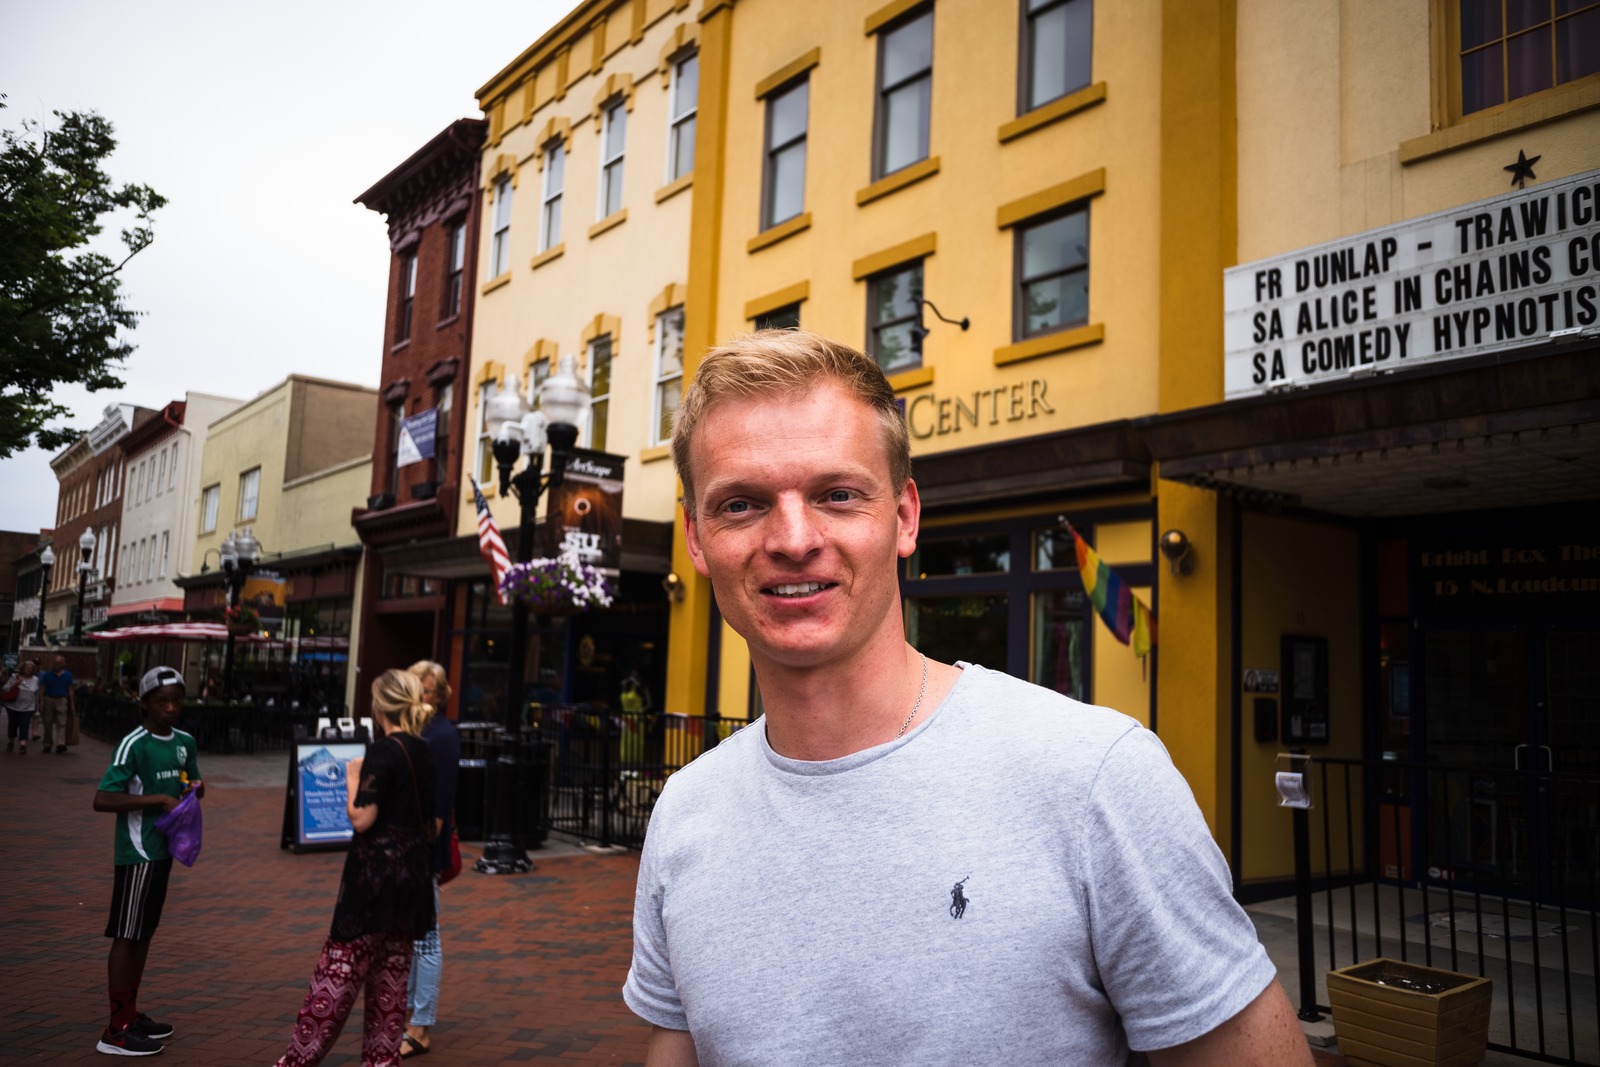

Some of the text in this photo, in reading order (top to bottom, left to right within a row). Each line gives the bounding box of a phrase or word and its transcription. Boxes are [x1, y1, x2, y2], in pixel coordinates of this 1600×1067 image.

[1255, 268, 1283, 303] FR
[1295, 237, 1398, 293] DUNLAP
[1455, 184, 1600, 254] TRAWIC
[1253, 308, 1284, 343] SA
[1297, 286, 1377, 335] ALICE
[1394, 275, 1422, 314] IN
[1434, 246, 1552, 305] CHAINS
[1253, 349, 1286, 385] SA
[1301, 322, 1411, 375] COMEDY
[1420, 549, 1490, 568] Bright
[1501, 547, 1547, 565] Box
